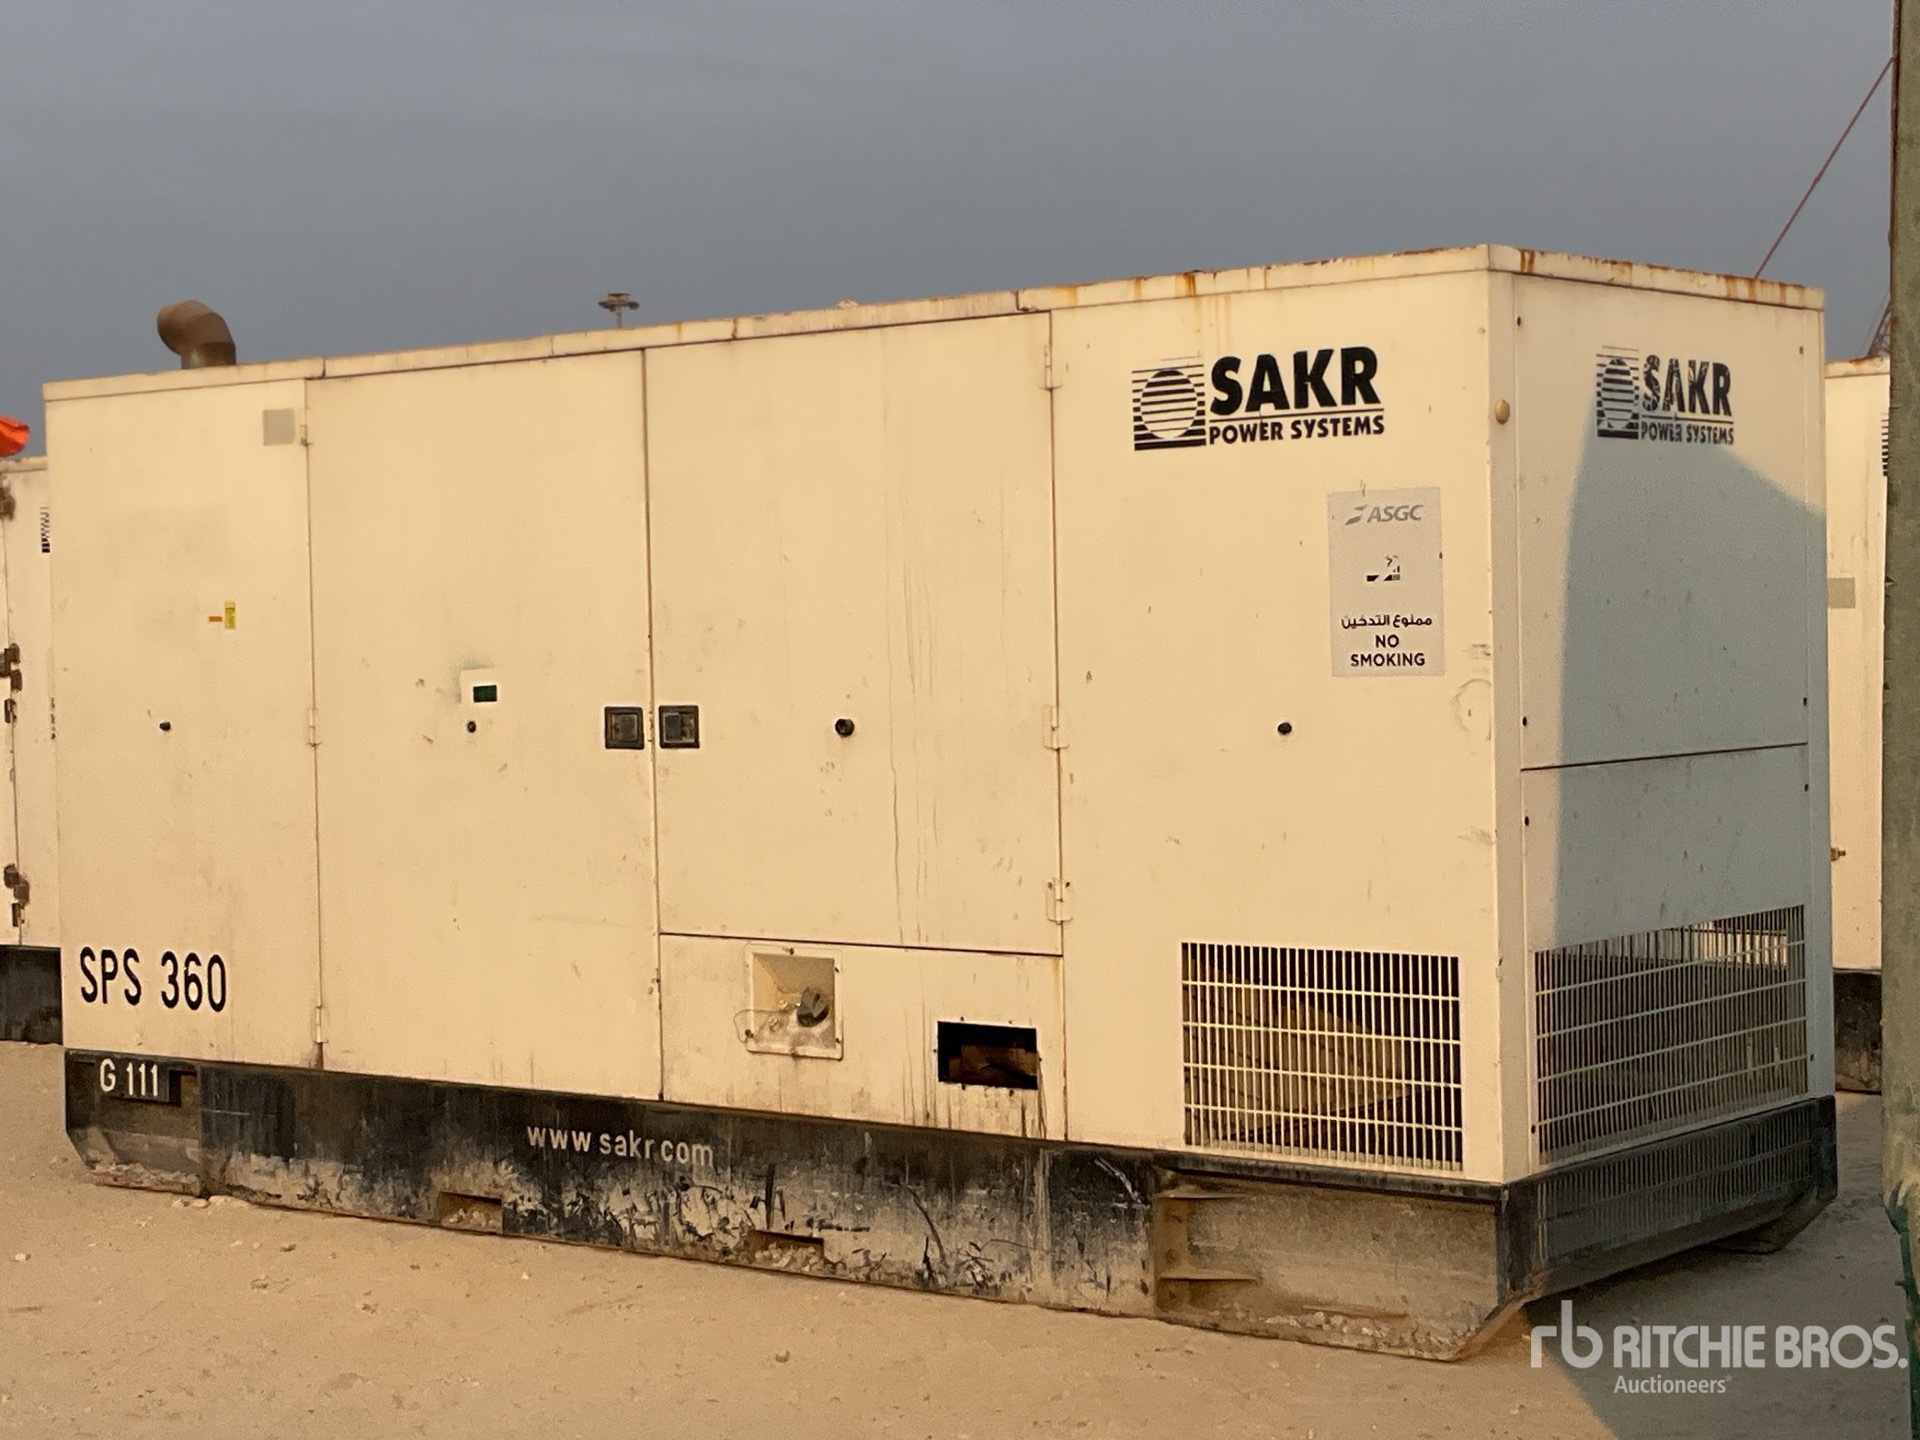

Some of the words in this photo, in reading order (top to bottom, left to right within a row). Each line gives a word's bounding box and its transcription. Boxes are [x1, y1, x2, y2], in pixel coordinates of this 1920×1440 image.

[1210, 346, 1382, 416] SAKR
[1642, 354, 1732, 417] SAKR
[1209, 421, 1284, 445] POWER
[1291, 415, 1385, 440] SYSTEMS
[1641, 420, 1682, 442] POWER
[1686, 423, 1734, 446] SYSTEMS
[1367, 504, 1424, 523] ASGC
[1341, 614, 1390, 629] التدخين
[1392, 614, 1433, 628] ممنوع
[1375, 634, 1400, 649] NO
[1350, 652, 1426, 667] SMOKING
[80, 946, 142, 1006] SPS
[160, 951, 227, 1013] 360
[100, 1058, 116, 1092] G
[126, 1062, 159, 1097] 111
